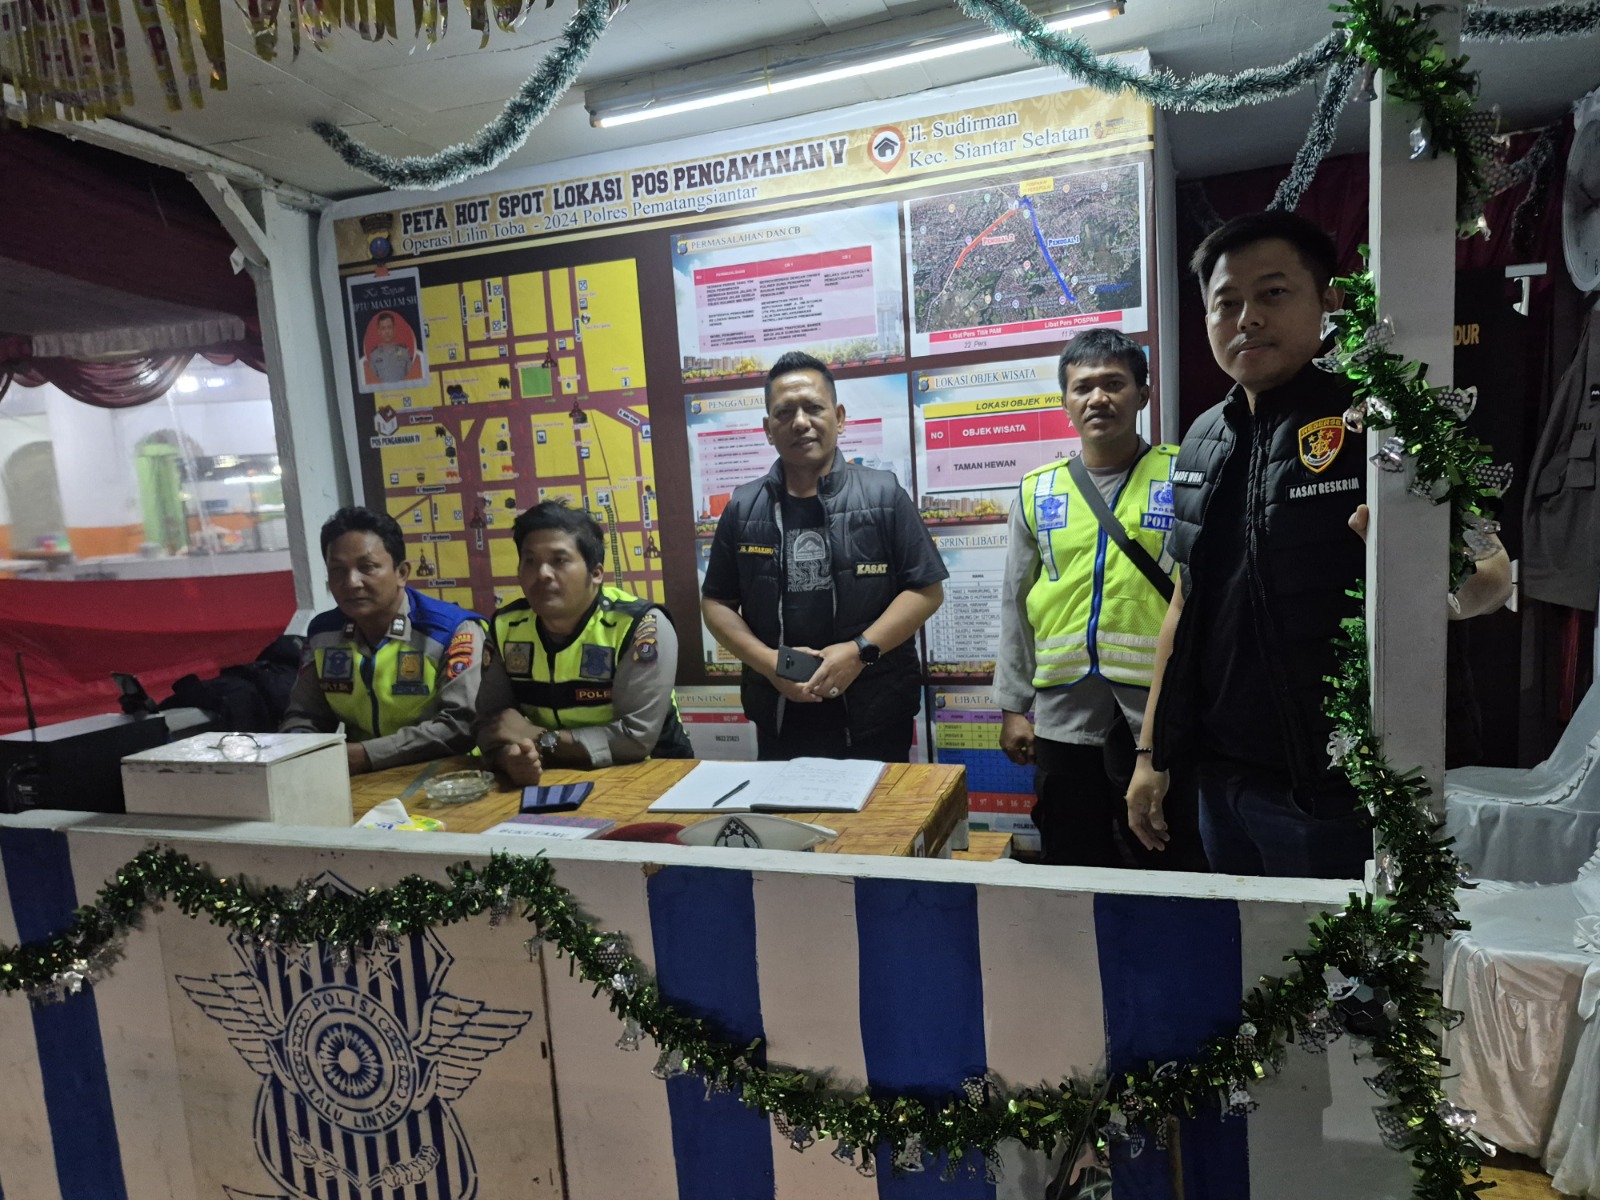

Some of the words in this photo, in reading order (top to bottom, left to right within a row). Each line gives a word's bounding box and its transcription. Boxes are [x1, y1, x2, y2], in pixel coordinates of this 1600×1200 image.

[931, 110, 1018, 139] Sudirman
[907, 149, 949, 169] Kec.
[954, 137, 1017, 163] Siantar
[1023, 125, 1090, 153] Selatan
[401, 210, 448, 236] PETA
[454, 200, 489, 227] HOT
[498, 191, 545, 220] SPOT
[553, 177, 623, 210] LOKASI
[631, 169, 669, 197] POS
[674, 140, 827, 192] PENGAMANAN
[828, 137, 847, 166] V
[402, 235, 453, 254] Operasi
[457, 225, 490, 246] Lilin
[493, 221, 526, 238] Toba
[544, 211, 579, 231] 2024
[583, 207, 628, 226] Polres
[632, 185, 759, 218] Pematangsiantar
[691, 232, 764, 250] PERMASALAHAN
[766, 228, 786, 239] DAN
[788, 226, 801, 235] CB
[1044, 320, 1060, 328] Libat
[1060, 319, 1072, 327] Pers
[1073, 316, 1099, 325] POSPAM
[935, 374, 969, 388] LOKASI
[970, 371, 1000, 385] OBJEK
[1001, 368, 1037, 381] WISATA
[709, 398, 748, 409] PENGGAL
[976, 401, 1009, 411] LOKASI
[1010, 398, 1041, 408] OBJEK
[930, 431, 944, 439] NO
[962, 427, 992, 437] OBJEK
[992, 424, 1026, 434] WISATA
[953, 462, 983, 471] TAMAN
[984, 460, 1016, 469] HEWAN
[1289, 484, 1318, 500] KASAT
[1318, 477, 1360, 494] RESKRIM
[940, 537, 969, 548] SPRINT
[972, 535, 997, 546] LIBAT
[857, 563, 888, 575] KASAT
[954, 695, 980, 704] LIBAT
[311, 991, 379, 1018] POLISI
[306, 1088, 343, 1123] LALU
[352, 1101, 403, 1129] LINTAS
